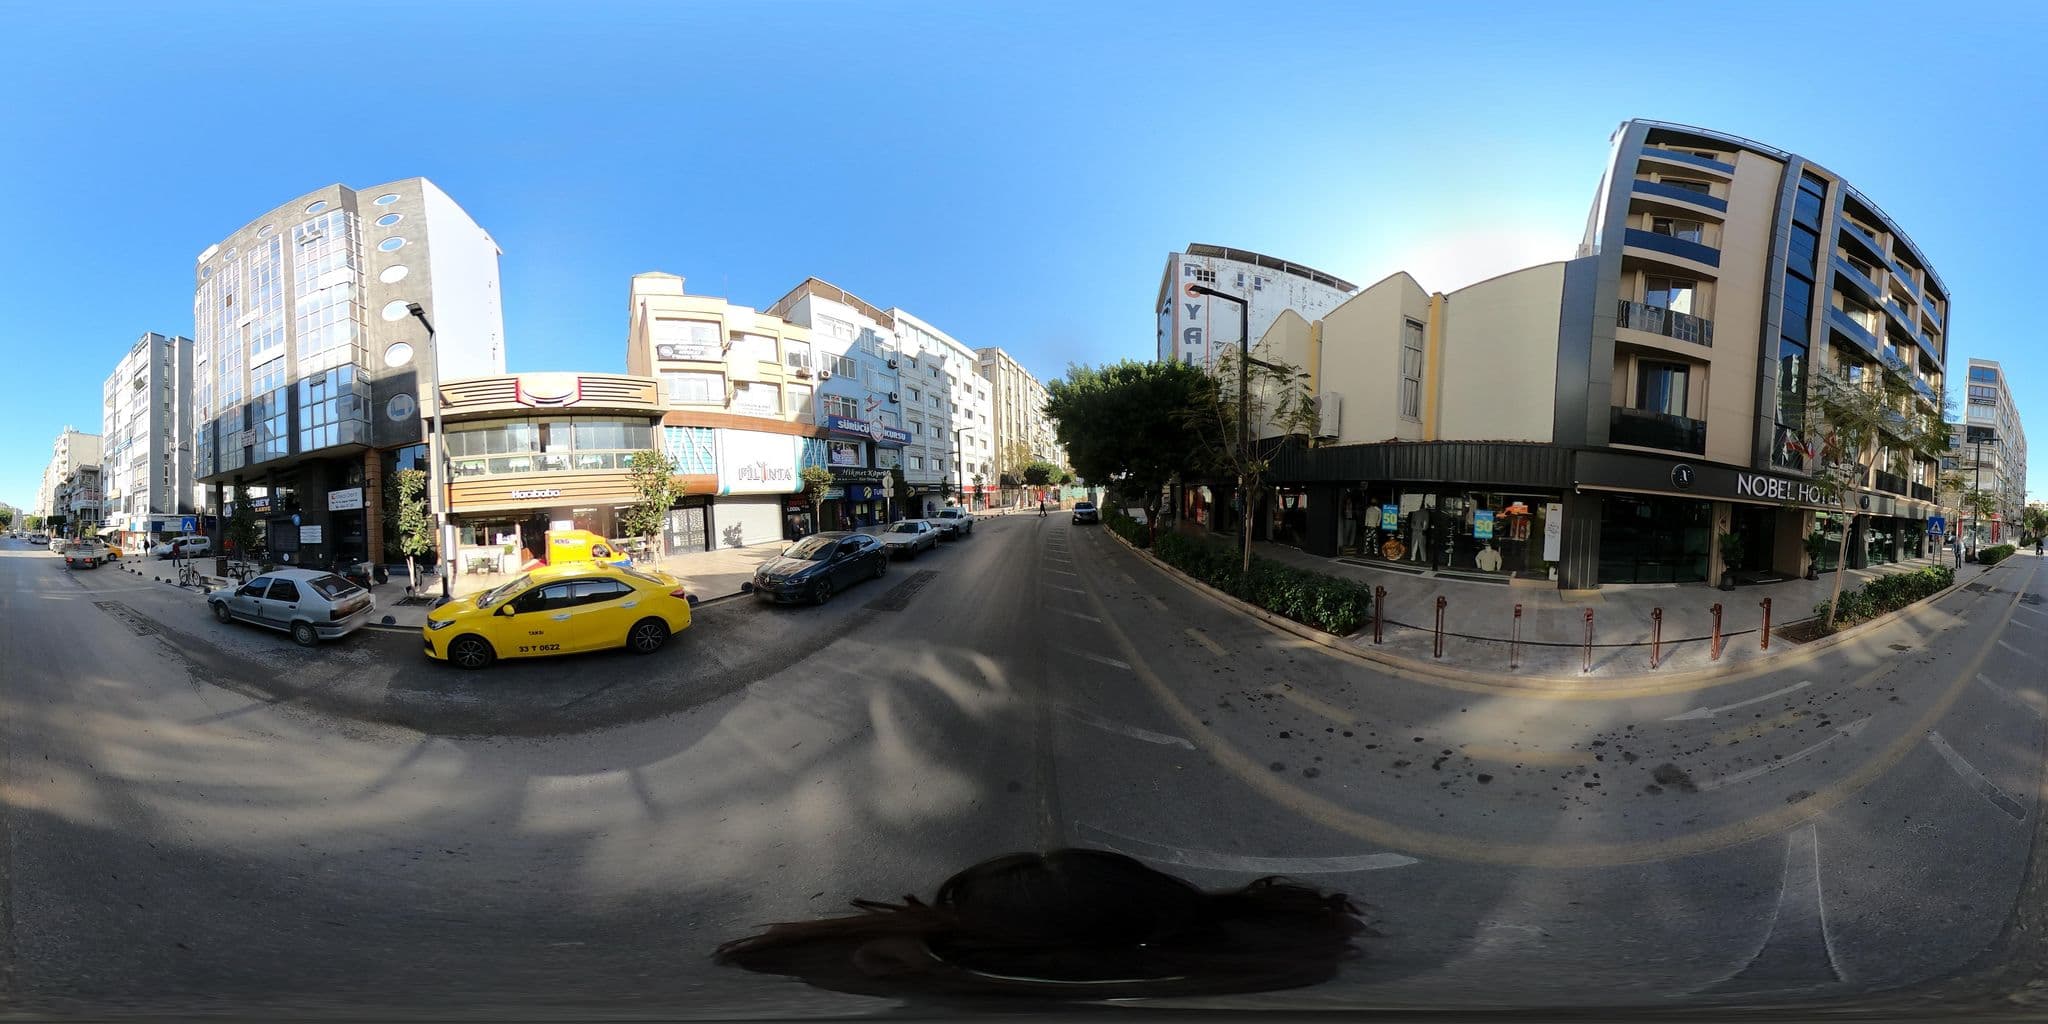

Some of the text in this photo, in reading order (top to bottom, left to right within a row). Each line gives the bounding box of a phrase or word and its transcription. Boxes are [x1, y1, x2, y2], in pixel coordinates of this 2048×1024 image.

[838, 419, 870, 434] SÜRÜCÜ
[1737, 473, 1795, 500] NOBEL
[1383, 513, 1398, 524] 50
[1476, 520, 1492, 532] 50
